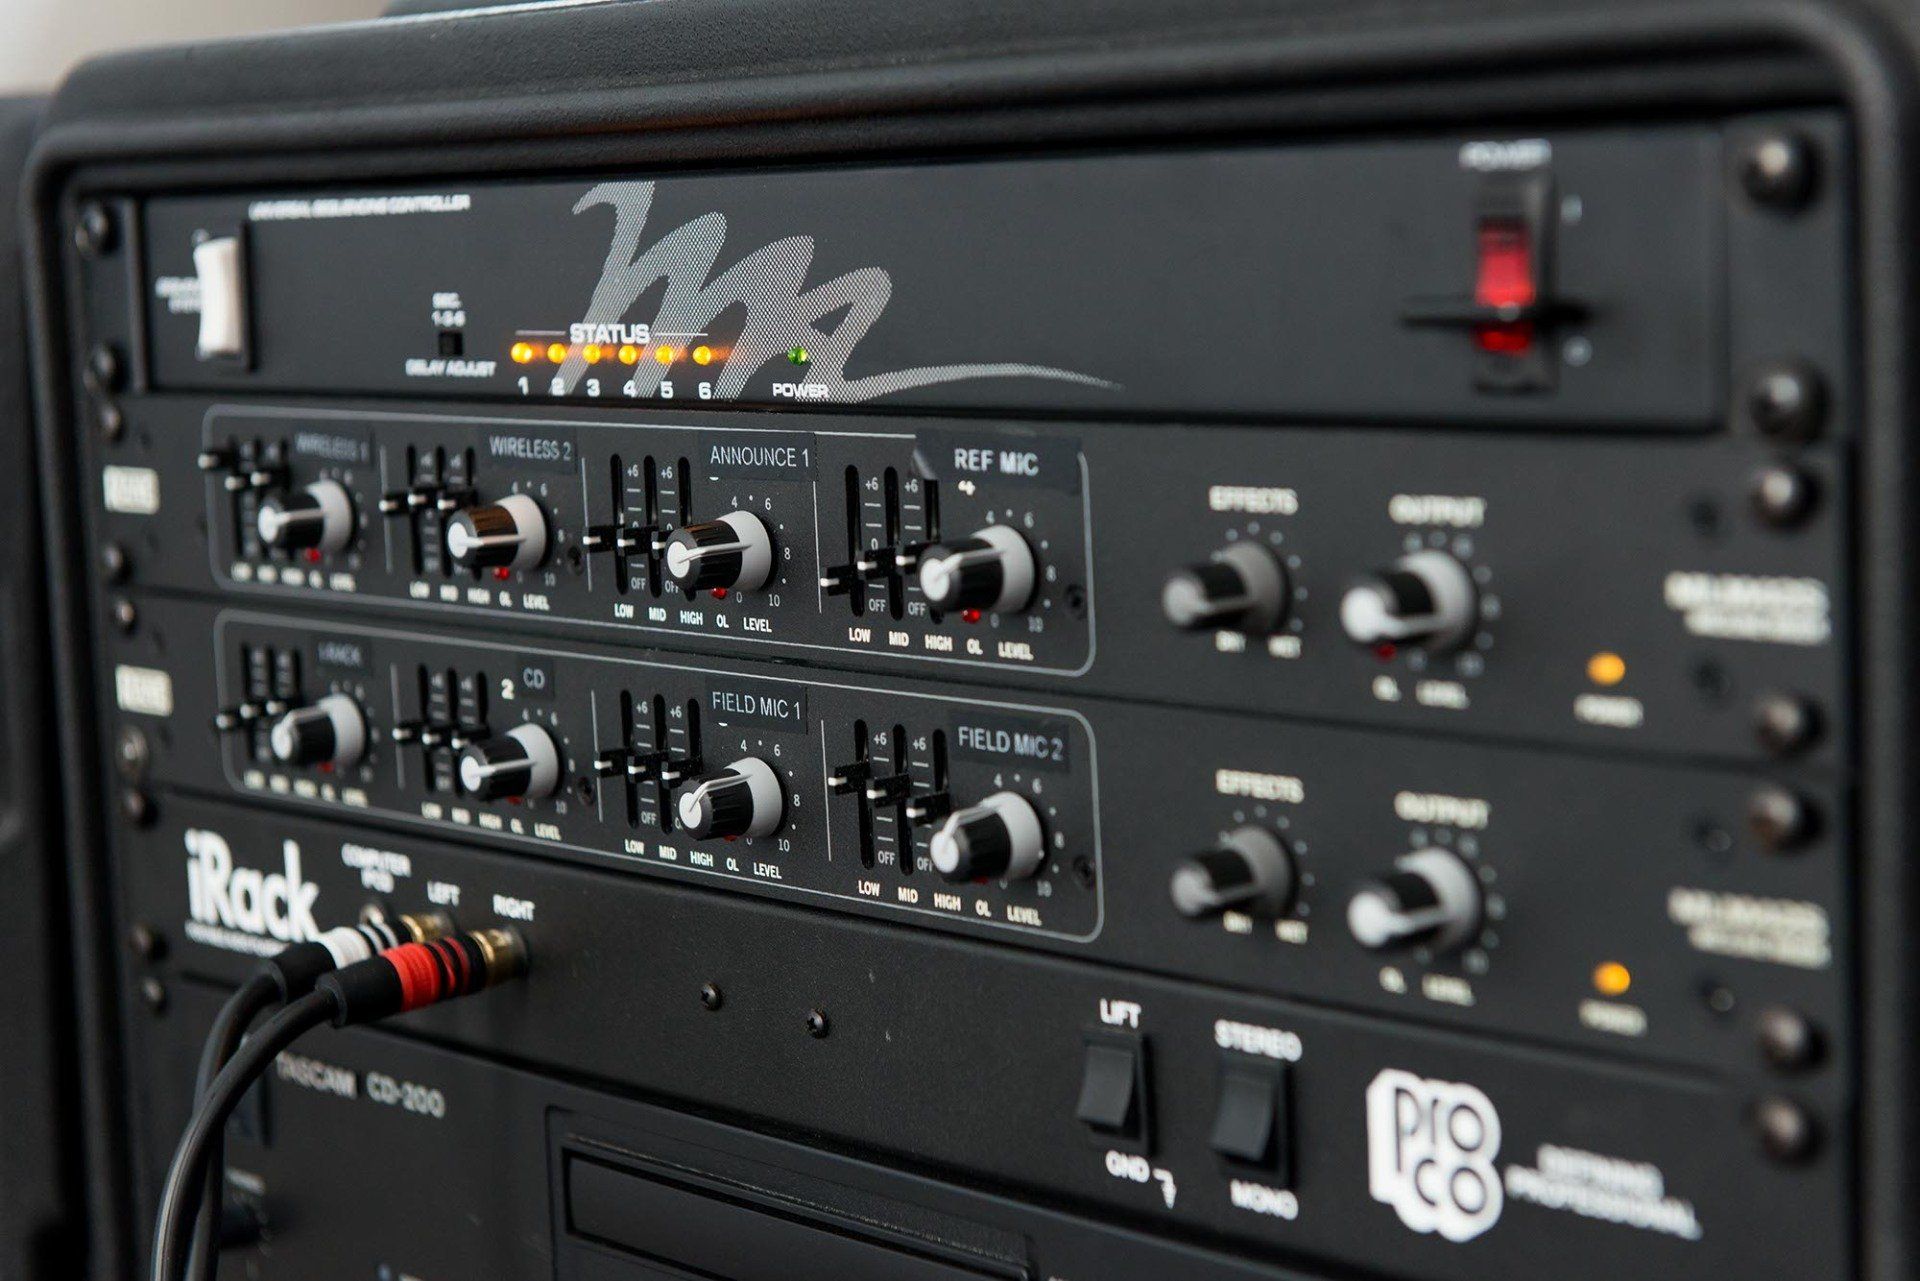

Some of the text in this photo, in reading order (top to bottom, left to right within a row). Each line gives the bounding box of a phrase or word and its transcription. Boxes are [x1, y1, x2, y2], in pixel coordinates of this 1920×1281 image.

[570, 323, 650, 344] STATUS
[517, 376, 711, 399] 1 2 3 4 5 6
[773, 383, 828, 398] POWER
[489, 435, 572, 461] WIRELESS 2
[710, 445, 809, 467] ANNOUNCE 1
[954, 448, 1039, 476] REF MIC
[627, 465, 639, 478] +6
[661, 466, 673, 479] +6
[865, 477, 878, 491] +6
[904, 478, 918, 493] +6
[731, 496, 738, 509] 4
[765, 497, 771, 510] 6
[784, 547, 791, 560] 8
[631, 577, 646, 591] OFF
[523, 594, 550, 611] LEVEL
[769, 593, 780, 607] 10
[868, 598, 886, 612] OFF
[614, 603, 634, 618] LOW
[649, 607, 667, 622] MID
[908, 601, 926, 616] OFF
[680, 610, 703, 625] HIGH
[717, 614, 729, 629] OL
[743, 617, 773, 633] LEVEL
[849, 627, 871, 643] LOW
[889, 631, 909, 647] MID
[925, 634, 953, 651] HIGH
[966, 638, 983, 655] OL
[998, 641, 1034, 661] LEVEL
[523, 667, 545, 690] CD
[501, 678, 514, 700] 2
[636, 701, 648, 714] +6
[670, 705, 682, 719] +6
[712, 691, 801, 720] FIELD MIC 1
[740, 739, 747, 752] 4
[873, 732, 887, 747] +6
[912, 737, 926, 751] +6
[958, 726, 1064, 762] FIELD MIC 2
[774, 744, 781, 757] 6
[793, 794, 801, 807] 8
[641, 811, 657, 826] OFF
[624, 838, 645, 855] LOW
[659, 845, 677, 861] MID
[778, 838, 790, 852] 10
[690, 851, 714, 867] HIGH
[726, 857, 739, 872] OL
[878, 850, 895, 866] OFF
[753, 862, 782, 880] LEVEL
[184, 828, 321, 943] iRack
[858, 880, 880, 897] LOW
[898, 886, 918, 904] MID
[934, 892, 961, 911] HIGH
[493, 893, 535, 922] RIGHT
[975, 899, 992, 917] OL
[1007, 905, 1042, 926] LEVEL
[1100, 998, 1142, 1028] LIFT
[367, 1071, 445, 1119] CD-200
